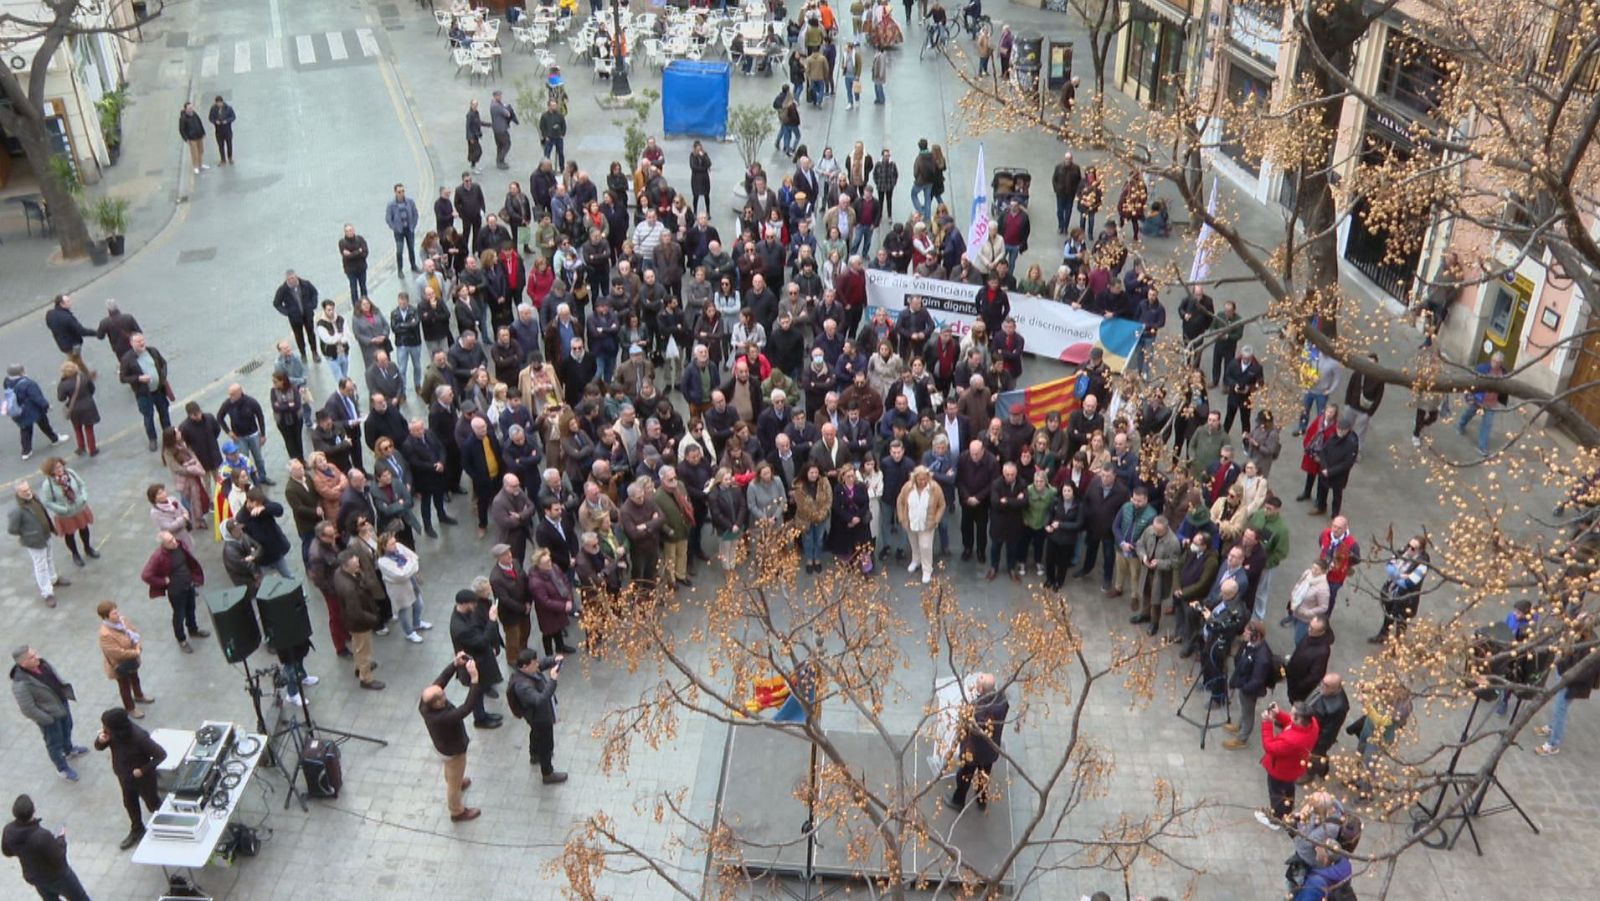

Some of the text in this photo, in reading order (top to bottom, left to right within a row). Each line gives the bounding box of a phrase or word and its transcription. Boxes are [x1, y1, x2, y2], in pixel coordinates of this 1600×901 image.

[869, 274, 974, 299] per als valencians
[943, 300, 978, 314] dignita
[1014, 313, 1026, 322] de
[951, 320, 971, 335] de
